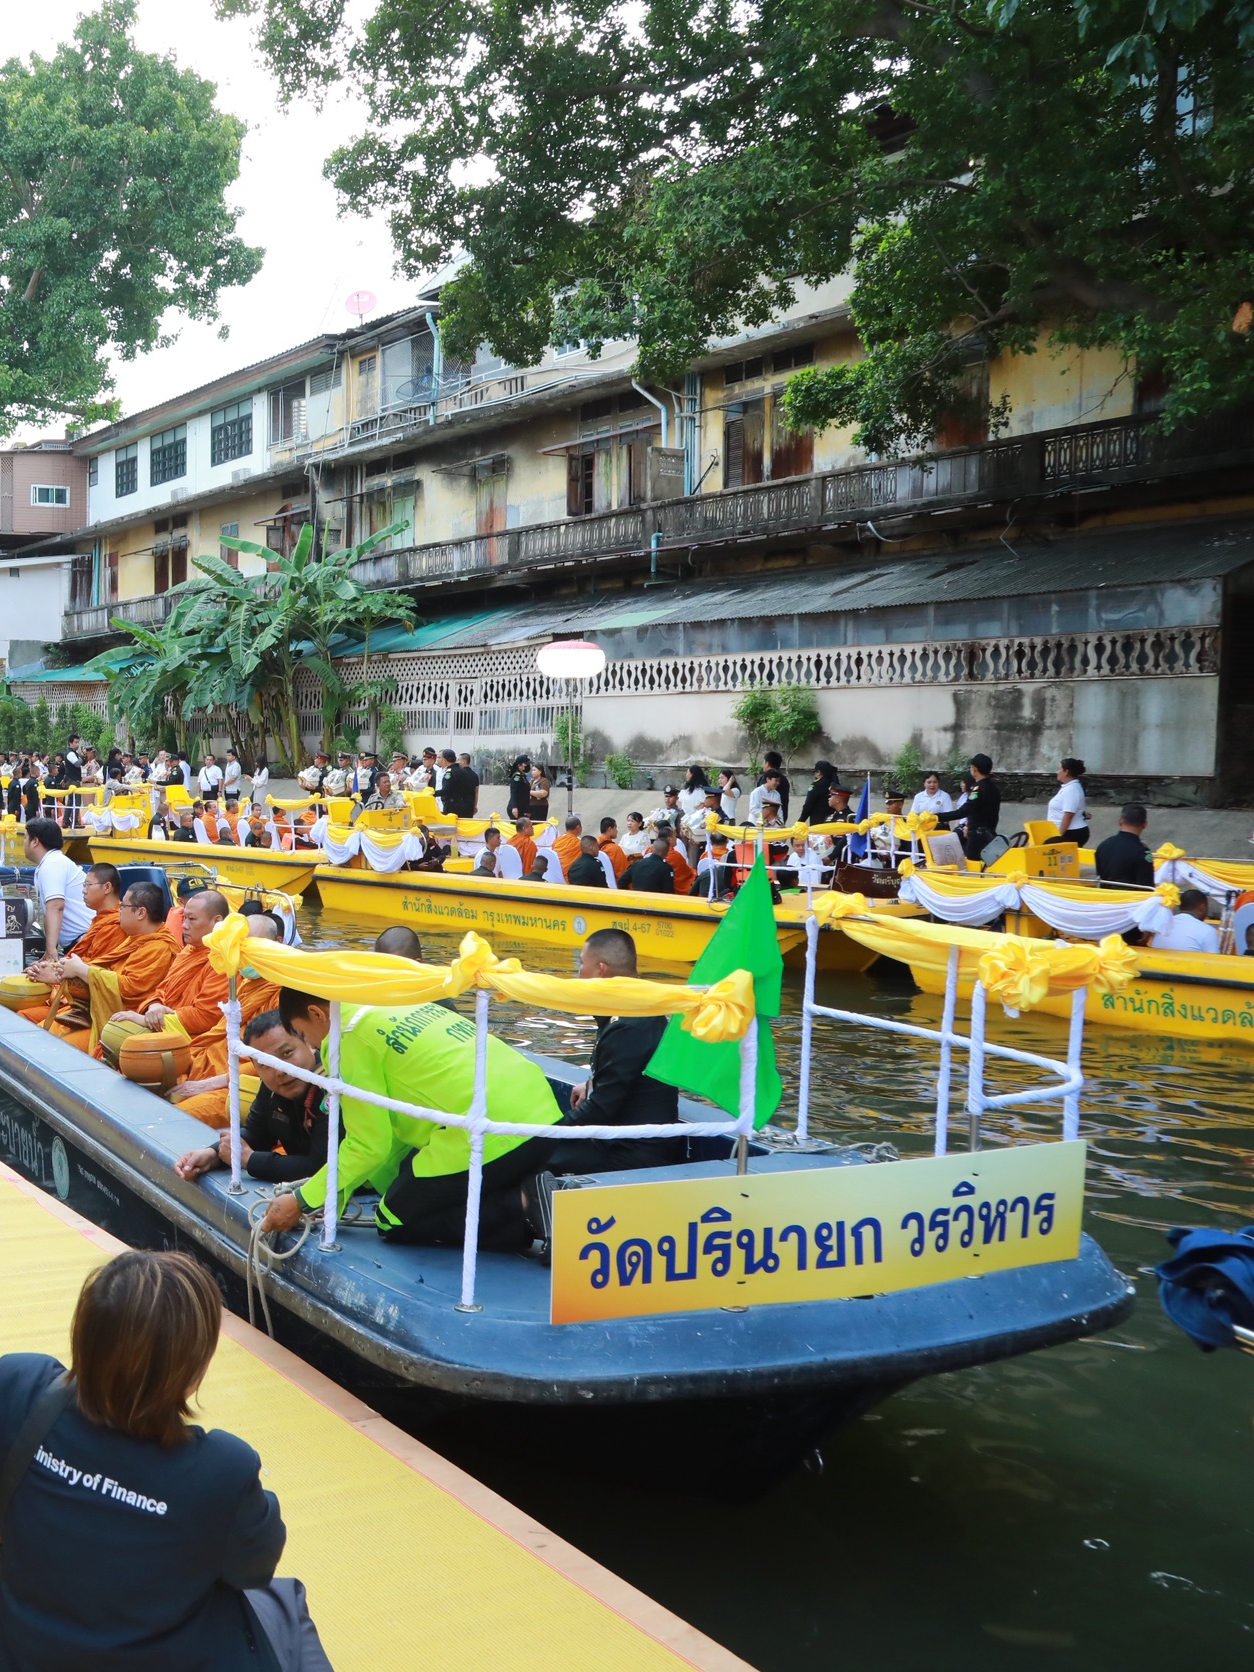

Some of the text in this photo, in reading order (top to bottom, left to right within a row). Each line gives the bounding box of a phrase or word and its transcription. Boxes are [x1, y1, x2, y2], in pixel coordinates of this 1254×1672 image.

[402, 895, 567, 932] สำนักสิ่งแวดล้อม กรุงเทพมหานคร
[578, 1180, 1057, 1290] วัดปรินายก วรวิหาร
[33, 1444, 168, 1515] inistry of Finance
